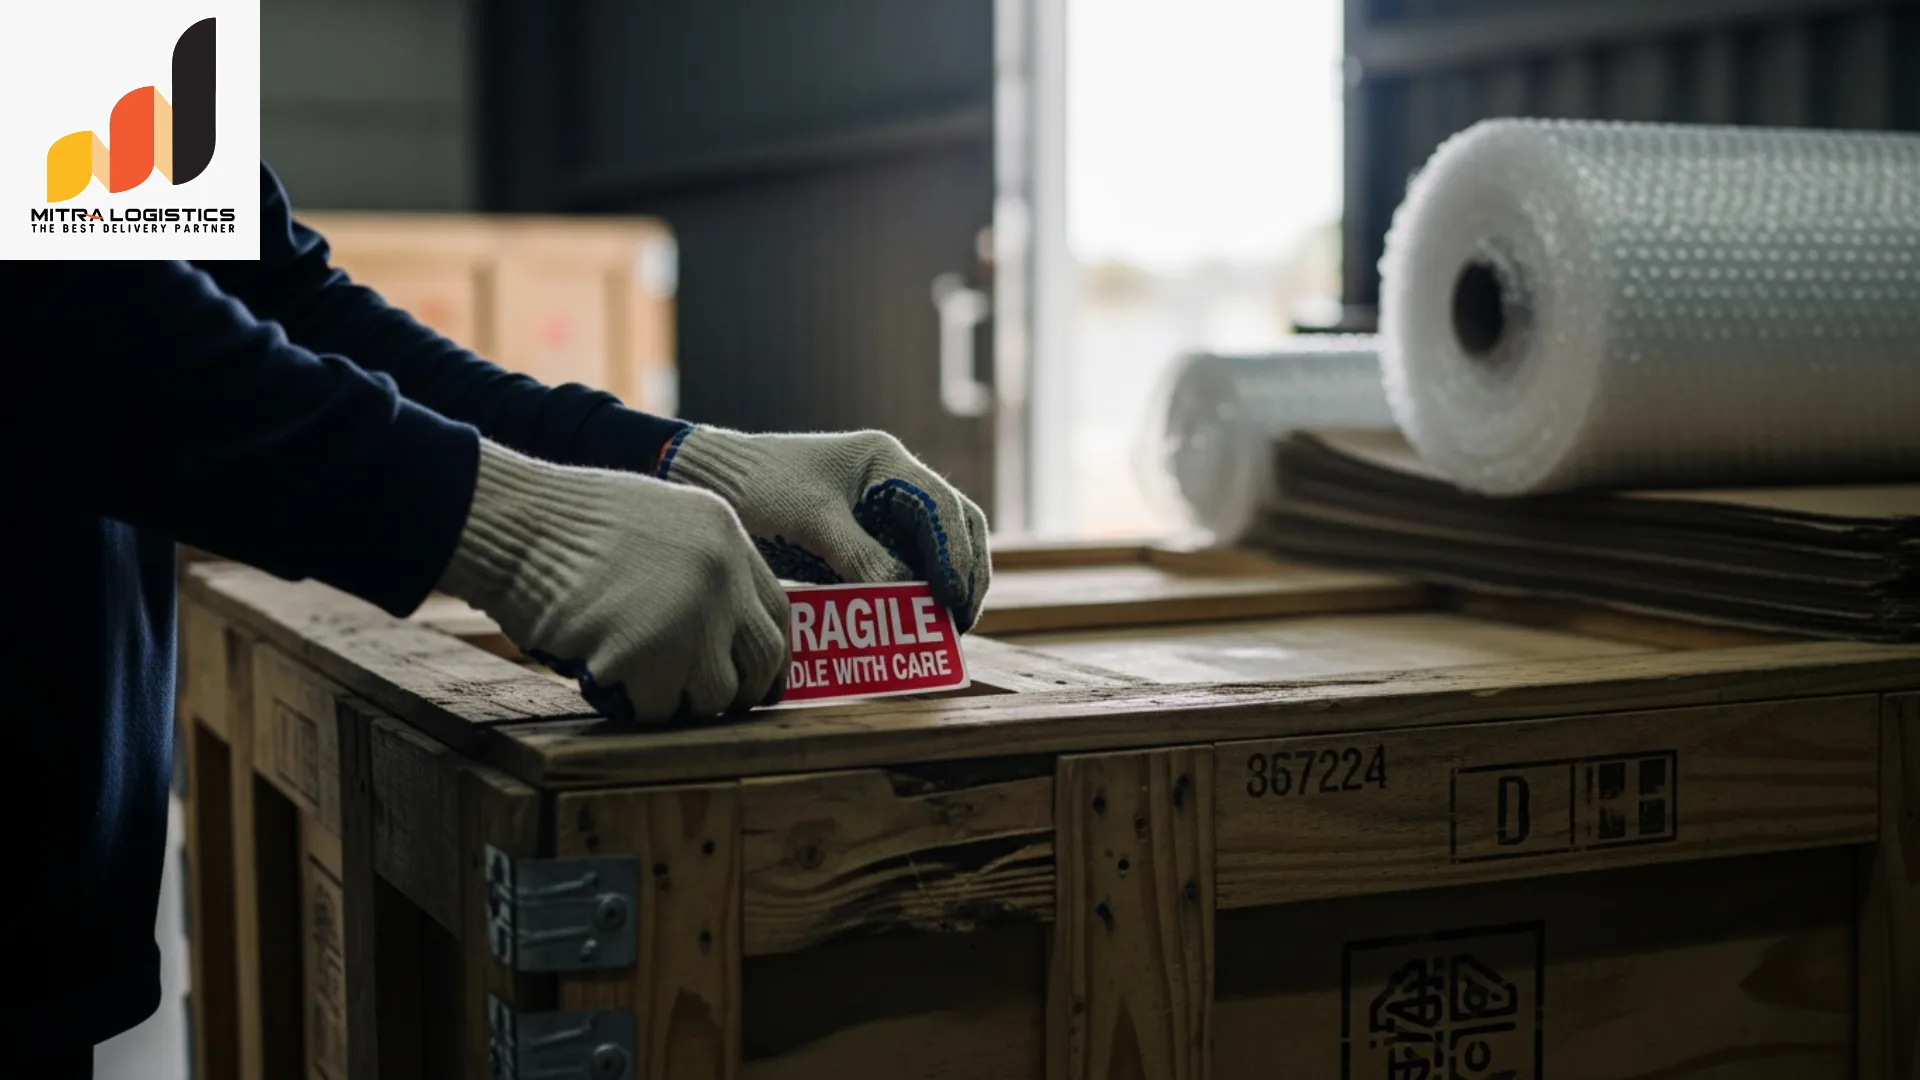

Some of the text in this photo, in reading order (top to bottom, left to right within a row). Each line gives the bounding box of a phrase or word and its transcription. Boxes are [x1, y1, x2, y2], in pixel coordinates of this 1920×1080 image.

[790, 597, 944, 653] RAGILE
[786, 649, 952, 690] DLE WITH CARE
[1246, 743, 1387, 798] 367224
